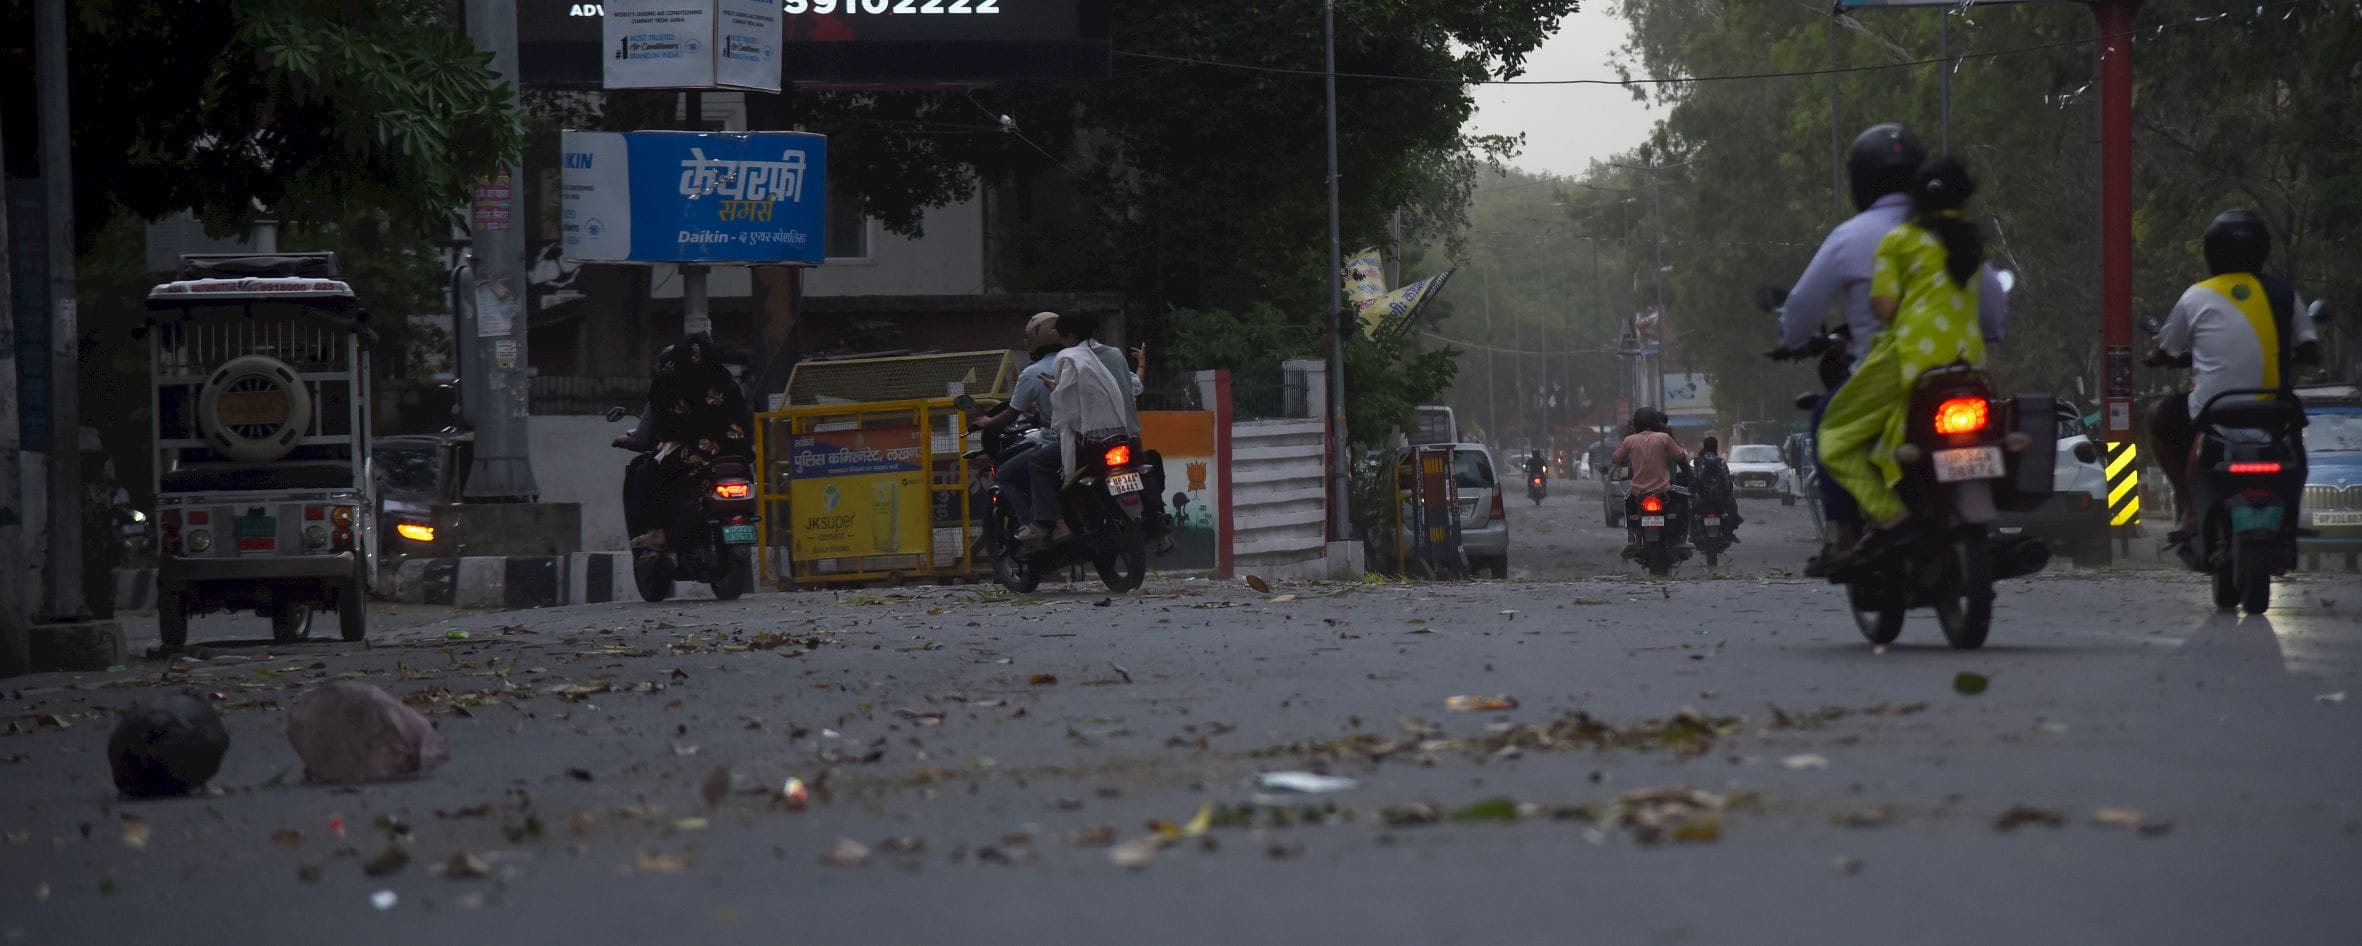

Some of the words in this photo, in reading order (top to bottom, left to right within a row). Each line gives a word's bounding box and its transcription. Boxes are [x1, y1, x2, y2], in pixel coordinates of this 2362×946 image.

[678, 230, 729, 243] Daikin
[739, 231, 749, 243] द
[750, 231, 772, 246] एयर
[793, 449, 826, 474] पुलिस
